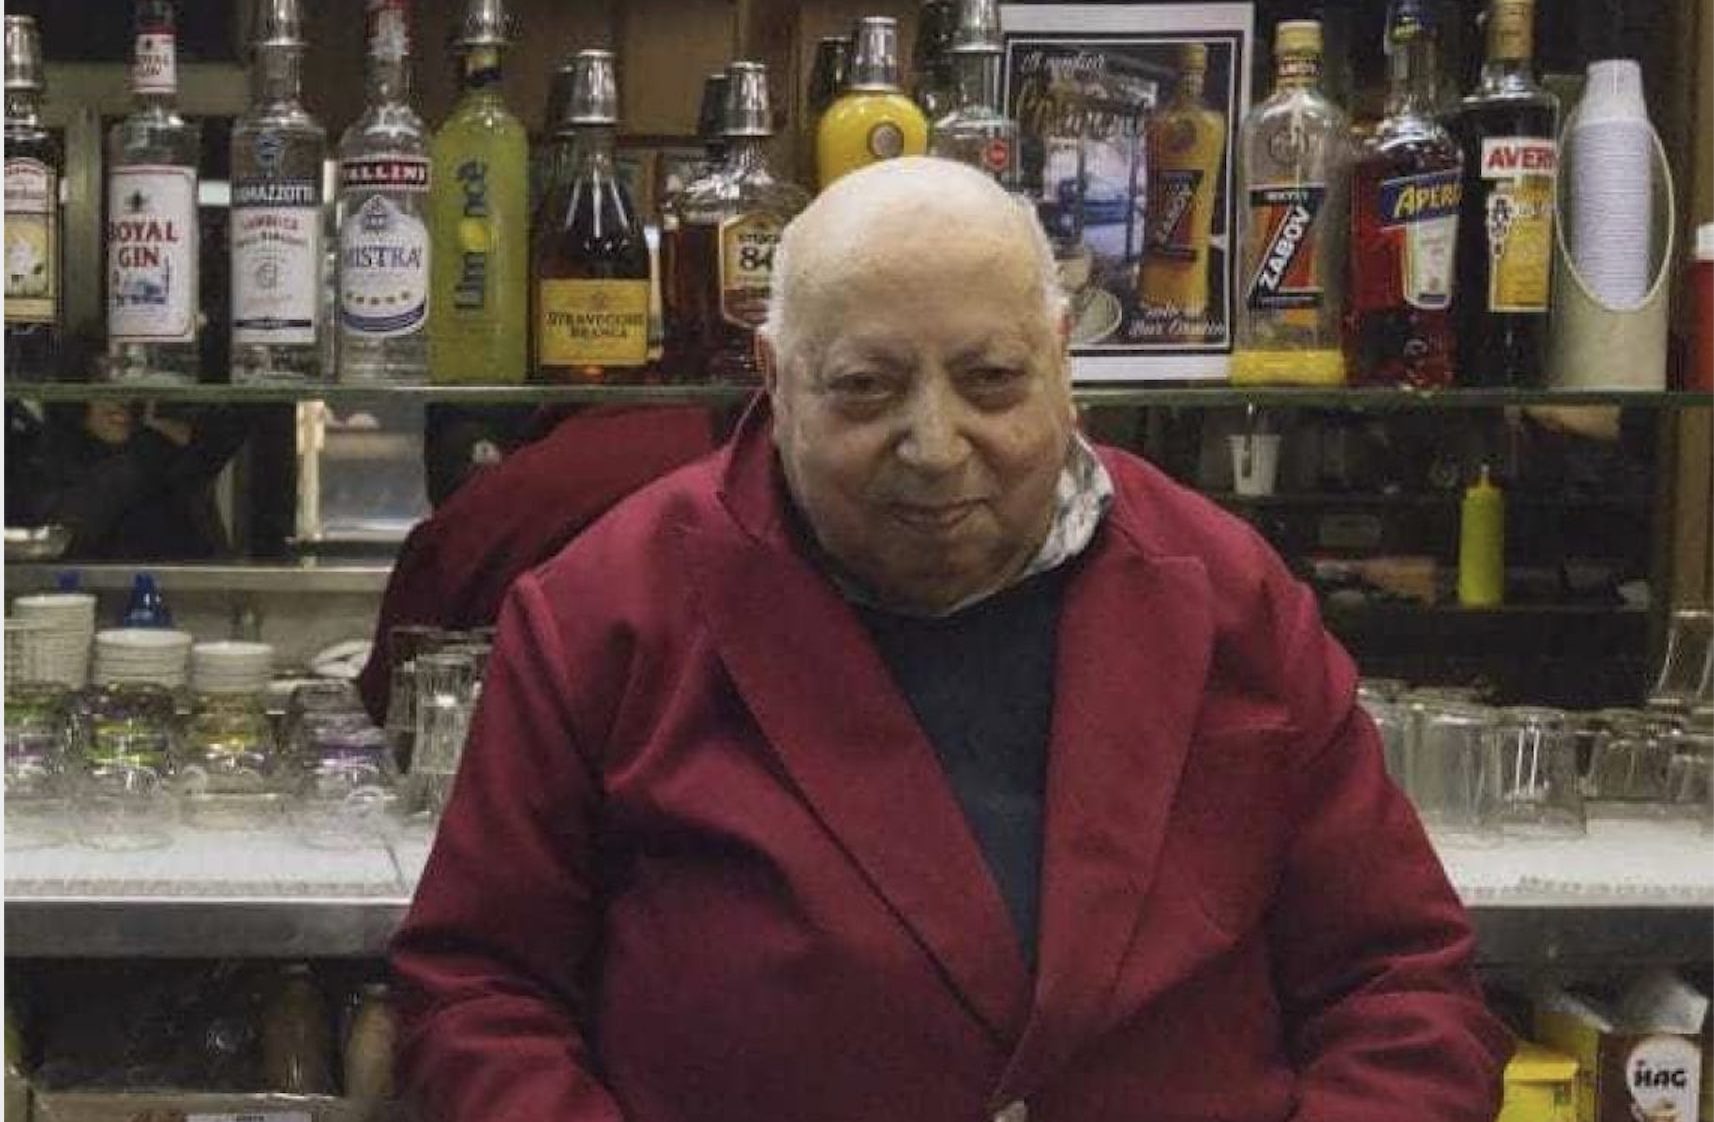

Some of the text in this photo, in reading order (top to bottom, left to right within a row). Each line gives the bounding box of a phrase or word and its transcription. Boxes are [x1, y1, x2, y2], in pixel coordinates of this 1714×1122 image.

[118, 246, 160, 268] GIN
[1259, 205, 1310, 290] ZABOV
[1634, 1070, 1688, 1087] HAG
